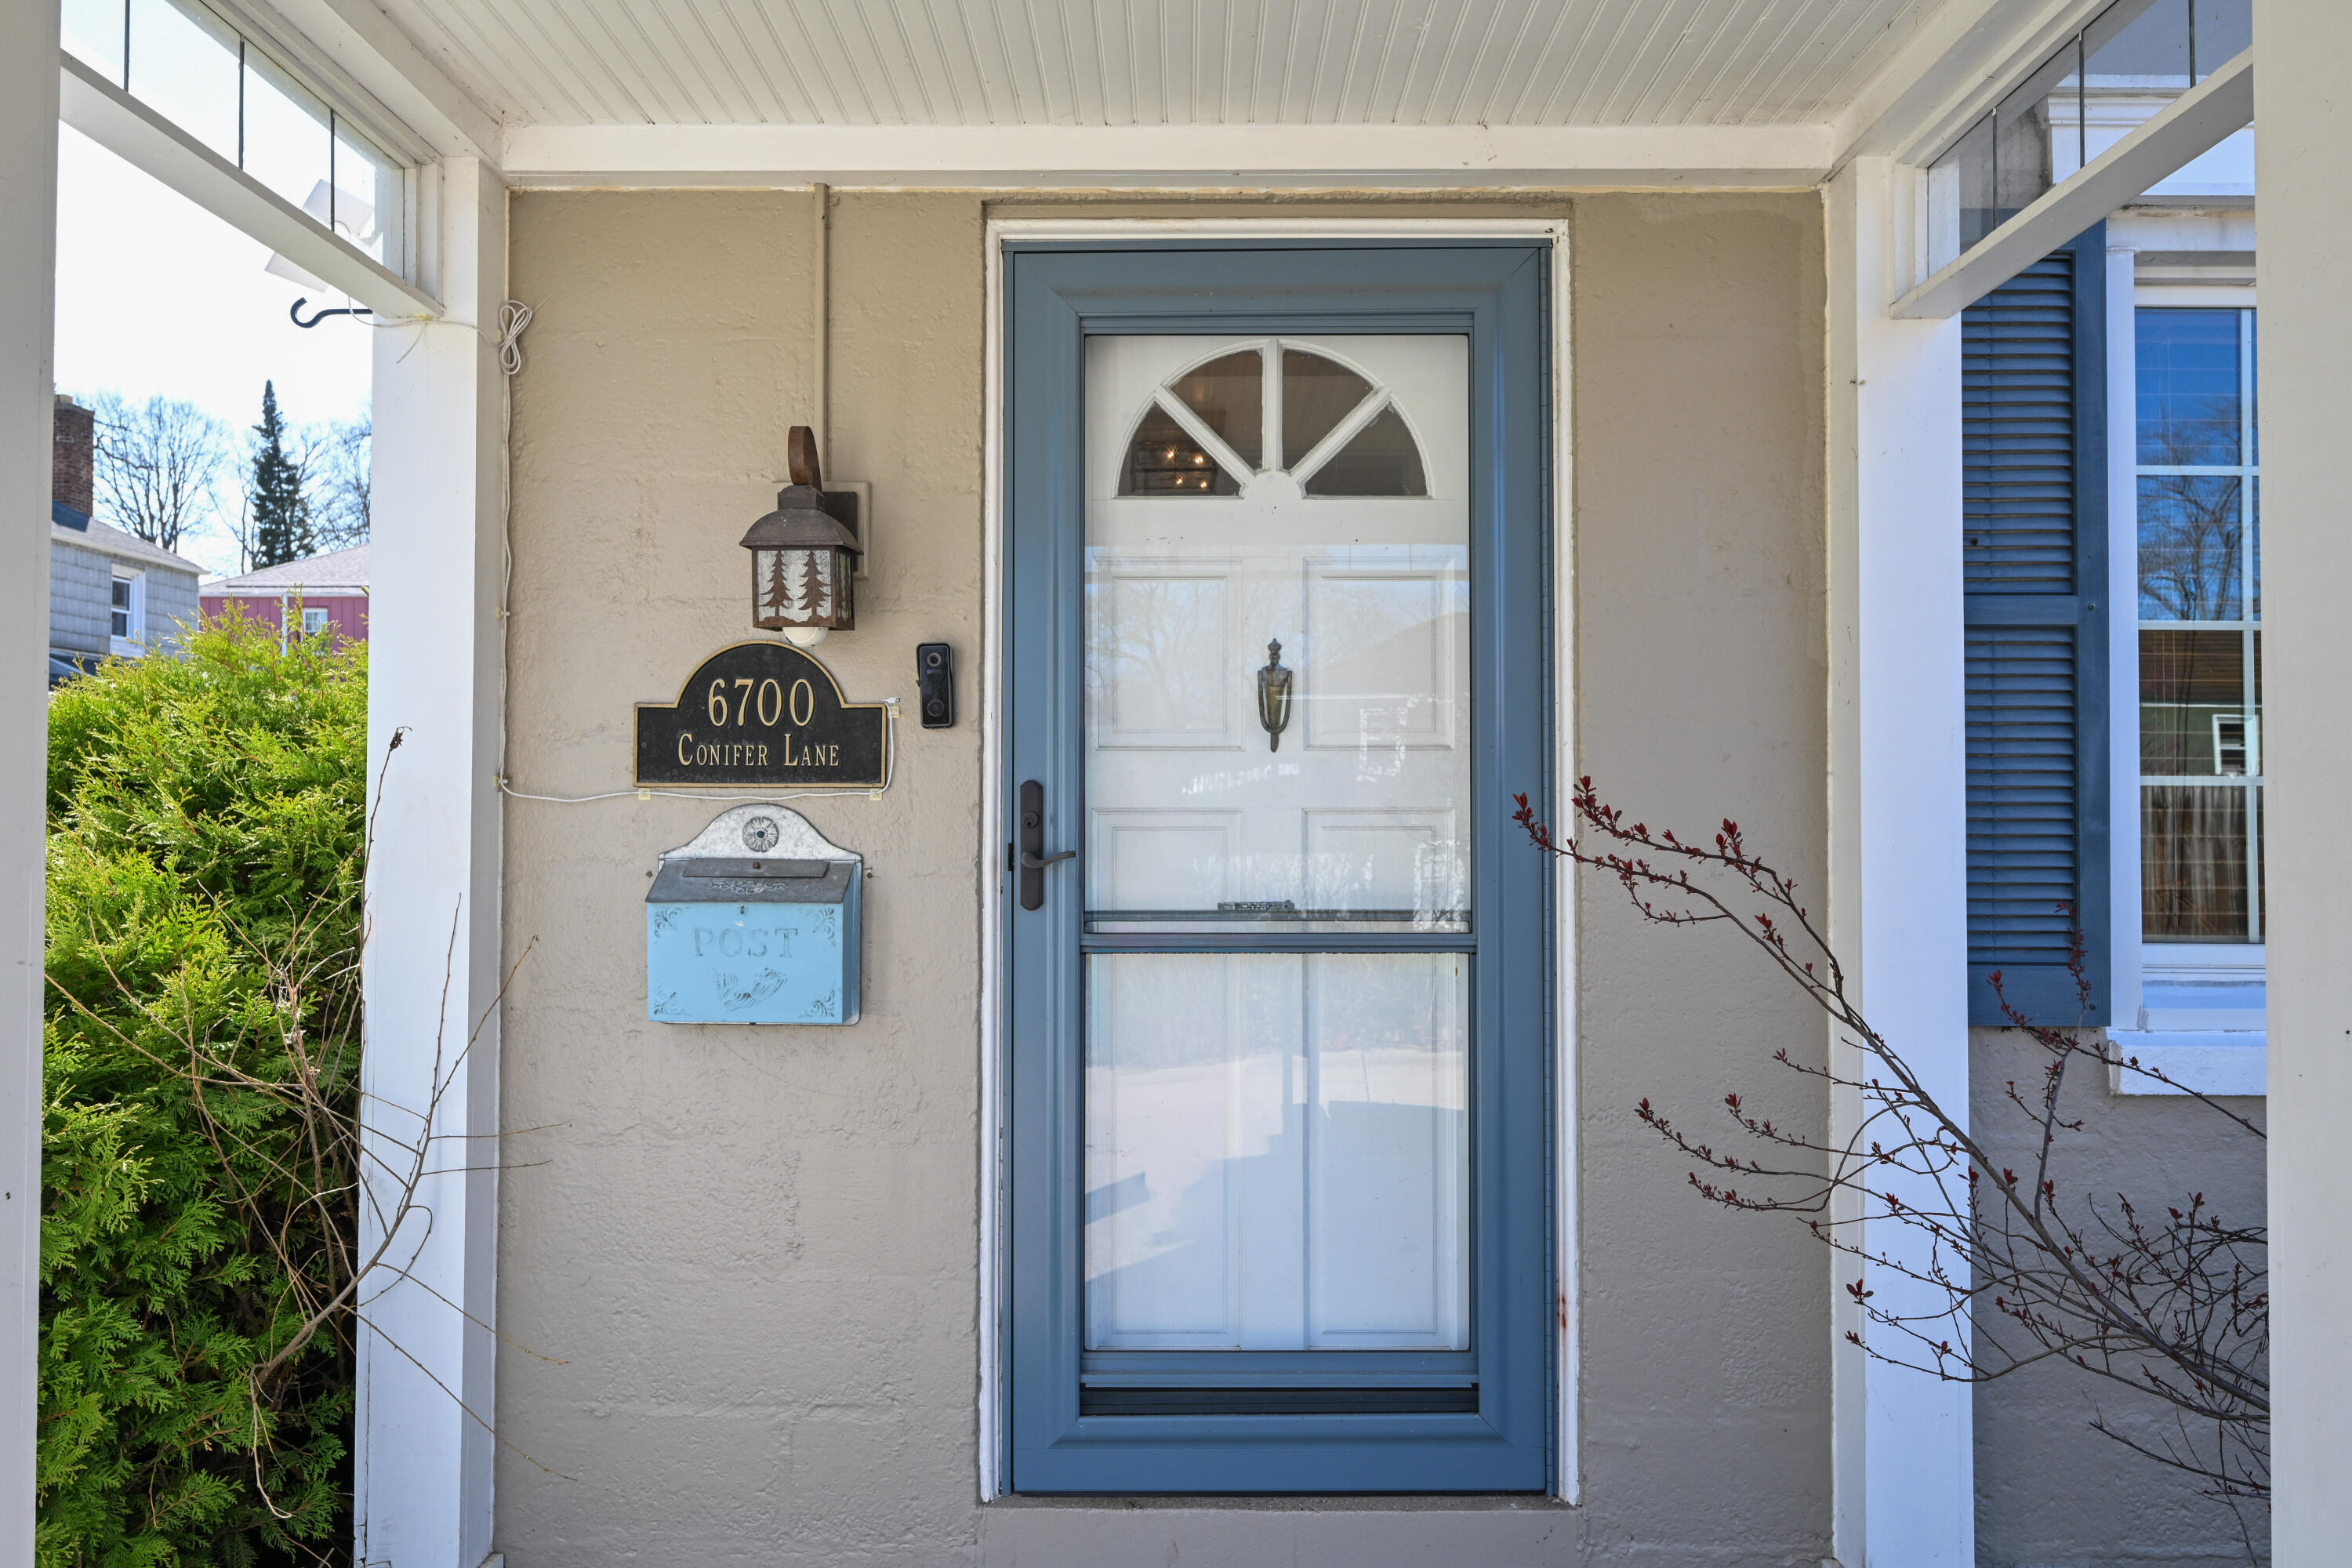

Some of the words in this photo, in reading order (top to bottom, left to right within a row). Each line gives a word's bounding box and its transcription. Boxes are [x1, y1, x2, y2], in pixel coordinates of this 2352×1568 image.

[708, 678, 815, 726] 6700
[678, 733, 768, 766] CONIFER
[784, 733, 840, 766] LANE
[691, 927, 798, 957] POST
